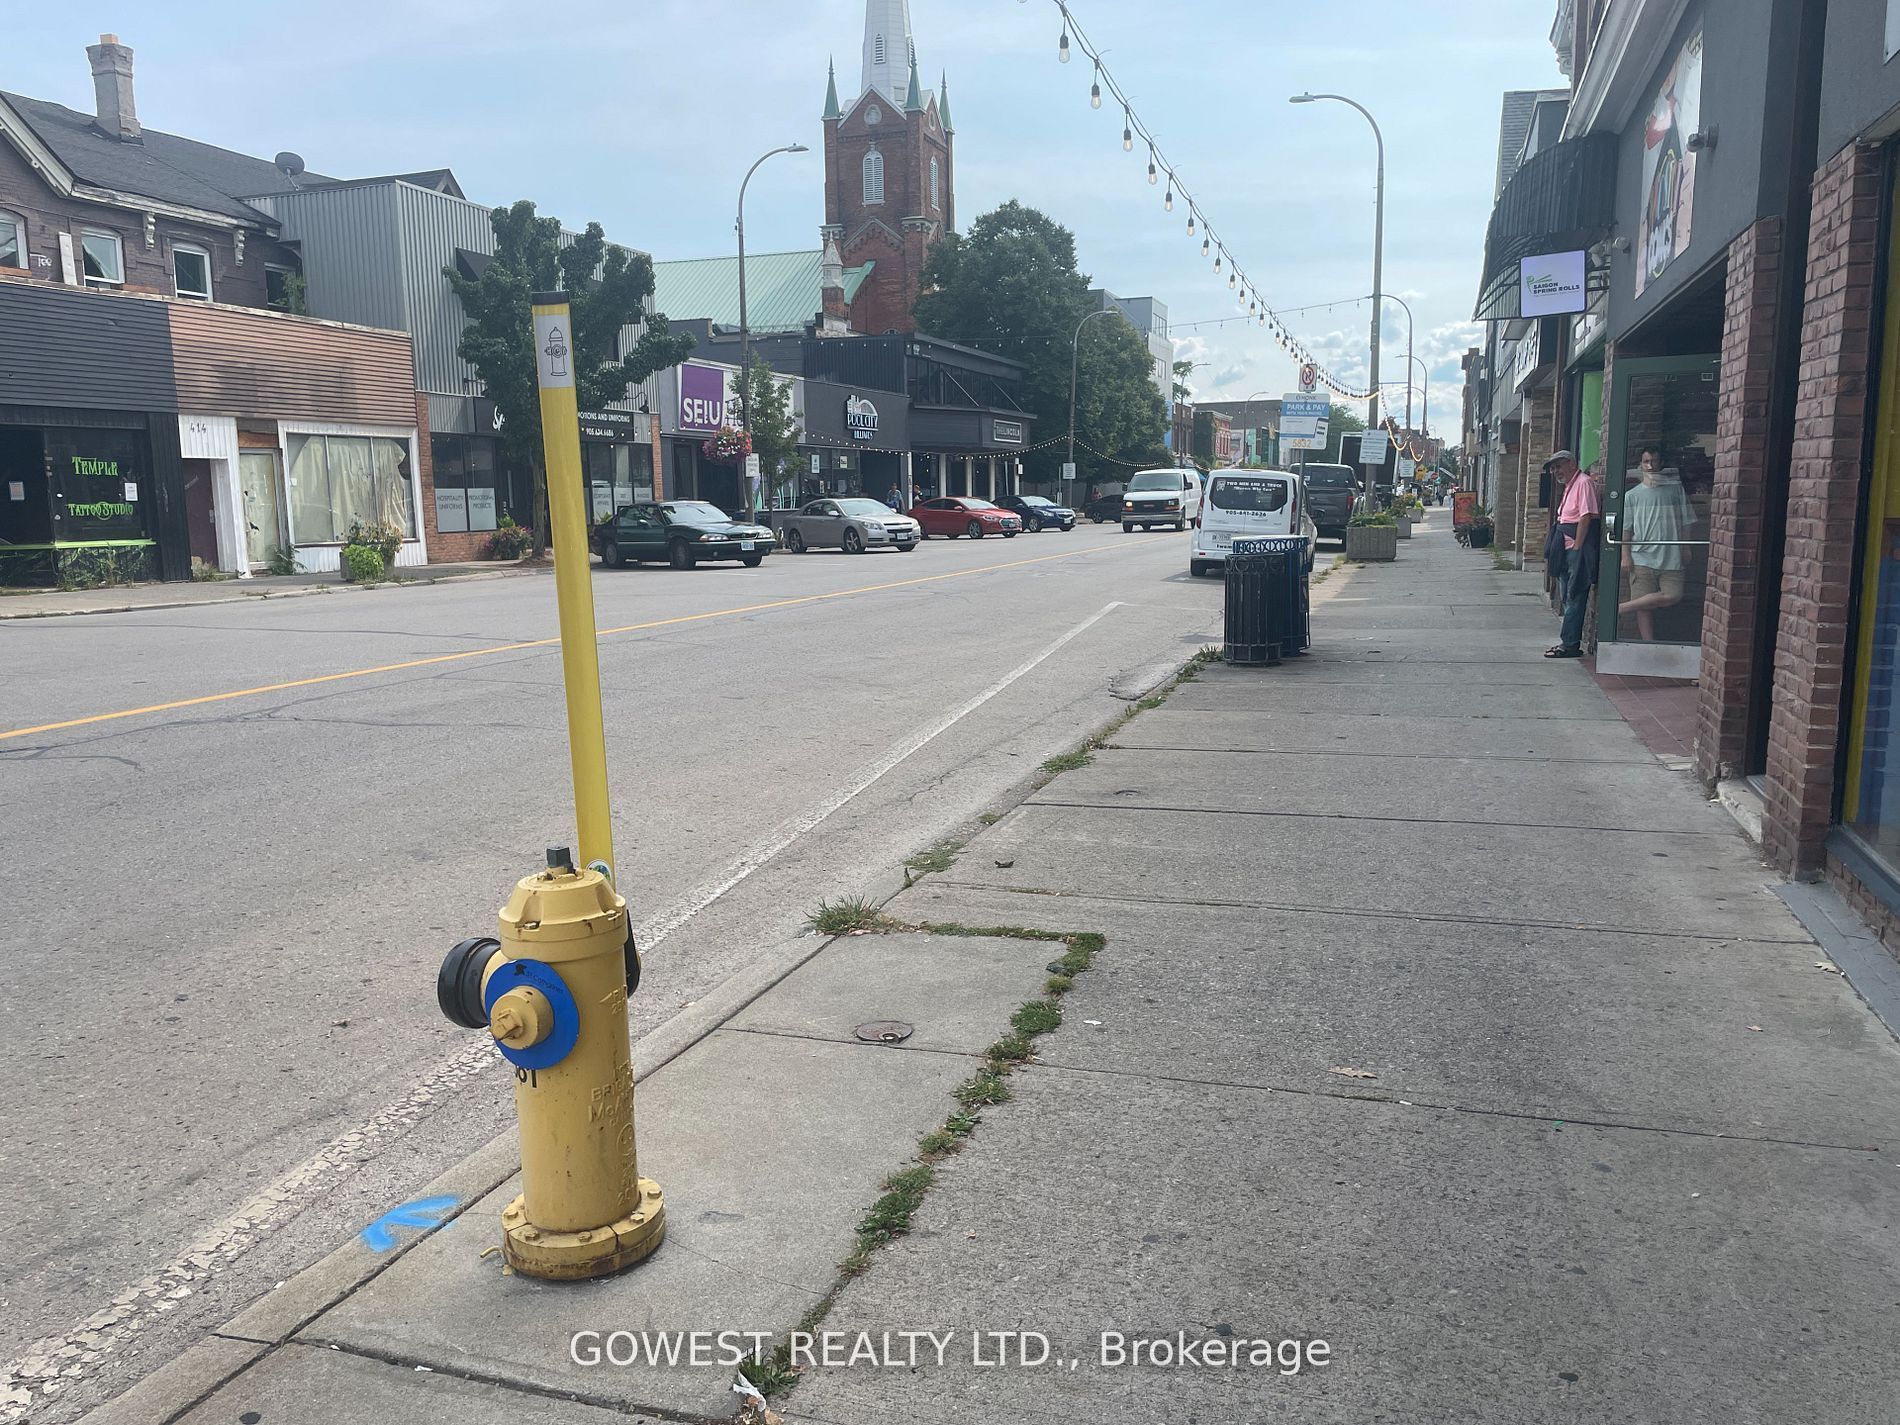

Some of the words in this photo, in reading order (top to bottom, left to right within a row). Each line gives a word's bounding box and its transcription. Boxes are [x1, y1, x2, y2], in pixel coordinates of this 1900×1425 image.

[1534, 282, 1559, 290] SAIGON
[683, 397, 720, 425] SEIU
[1286, 403, 1305, 411] PARK
[1306, 403, 1312, 411] &
[1292, 438, 1312, 447] 5832
